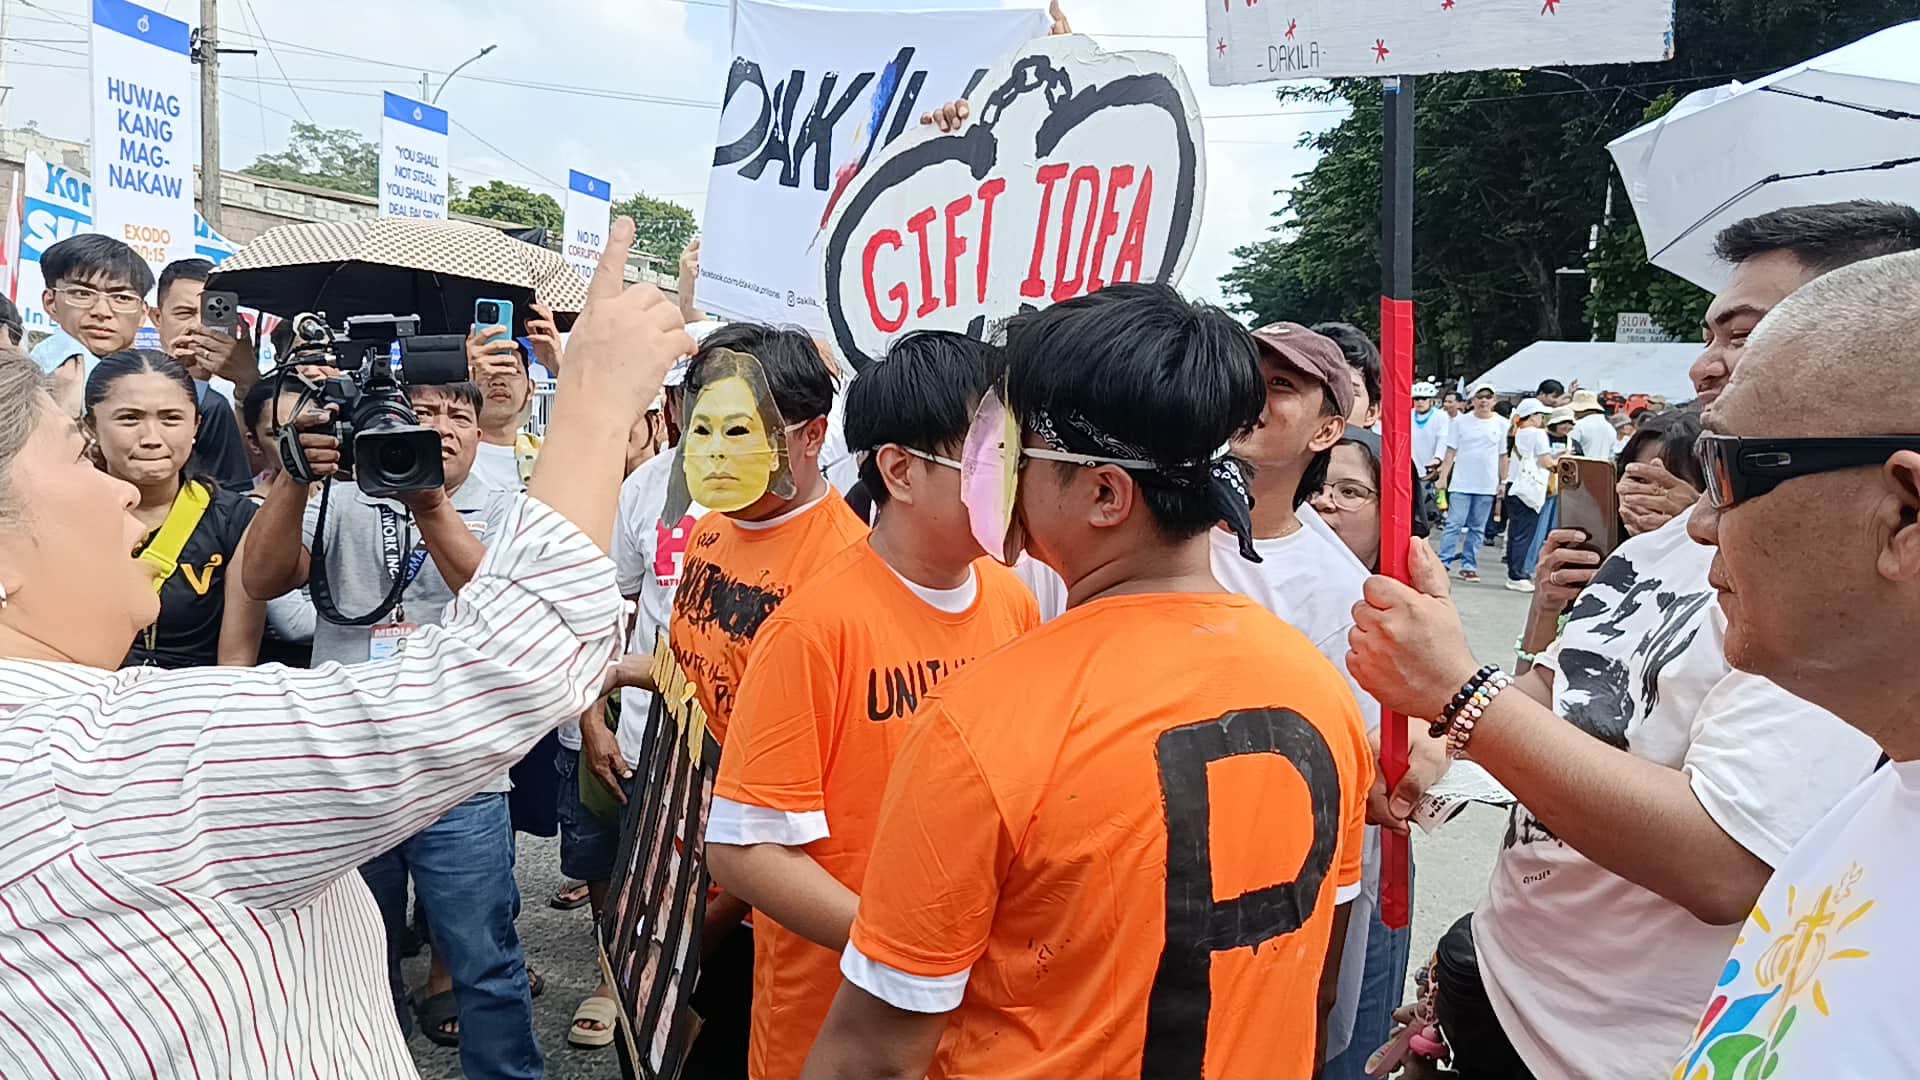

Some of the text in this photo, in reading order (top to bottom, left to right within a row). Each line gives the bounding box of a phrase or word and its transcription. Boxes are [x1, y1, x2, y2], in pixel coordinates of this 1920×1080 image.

[108, 77, 180, 118] HUWAG
[118, 108, 173, 143] KANG
[712, 46, 989, 192] DAKI
[120, 138, 170, 169] MAG-
[416, 151, 439, 168] SHALL
[109, 163, 182, 199] NAKAW
[394, 164, 412, 180] NOT
[386, 182, 445, 206] YOU SHALL NOT
[125, 223, 171, 245] EXODO
[577, 229, 600, 247] NO TO
[568, 244, 601, 261] CORRUPTIO
[862, 162, 1152, 333] GIFT IDEA
[582, 264, 592, 279] TO
[1621, 316, 1648, 327] SLOW
[386, 554, 401, 580] INC.
[405, 549, 427, 581] GMA
[656, 578, 679, 587] ARTI
[374, 627, 413, 638] MEDIA
[867, 657, 975, 721] UNIT
[1140, 705, 1342, 1080] P
